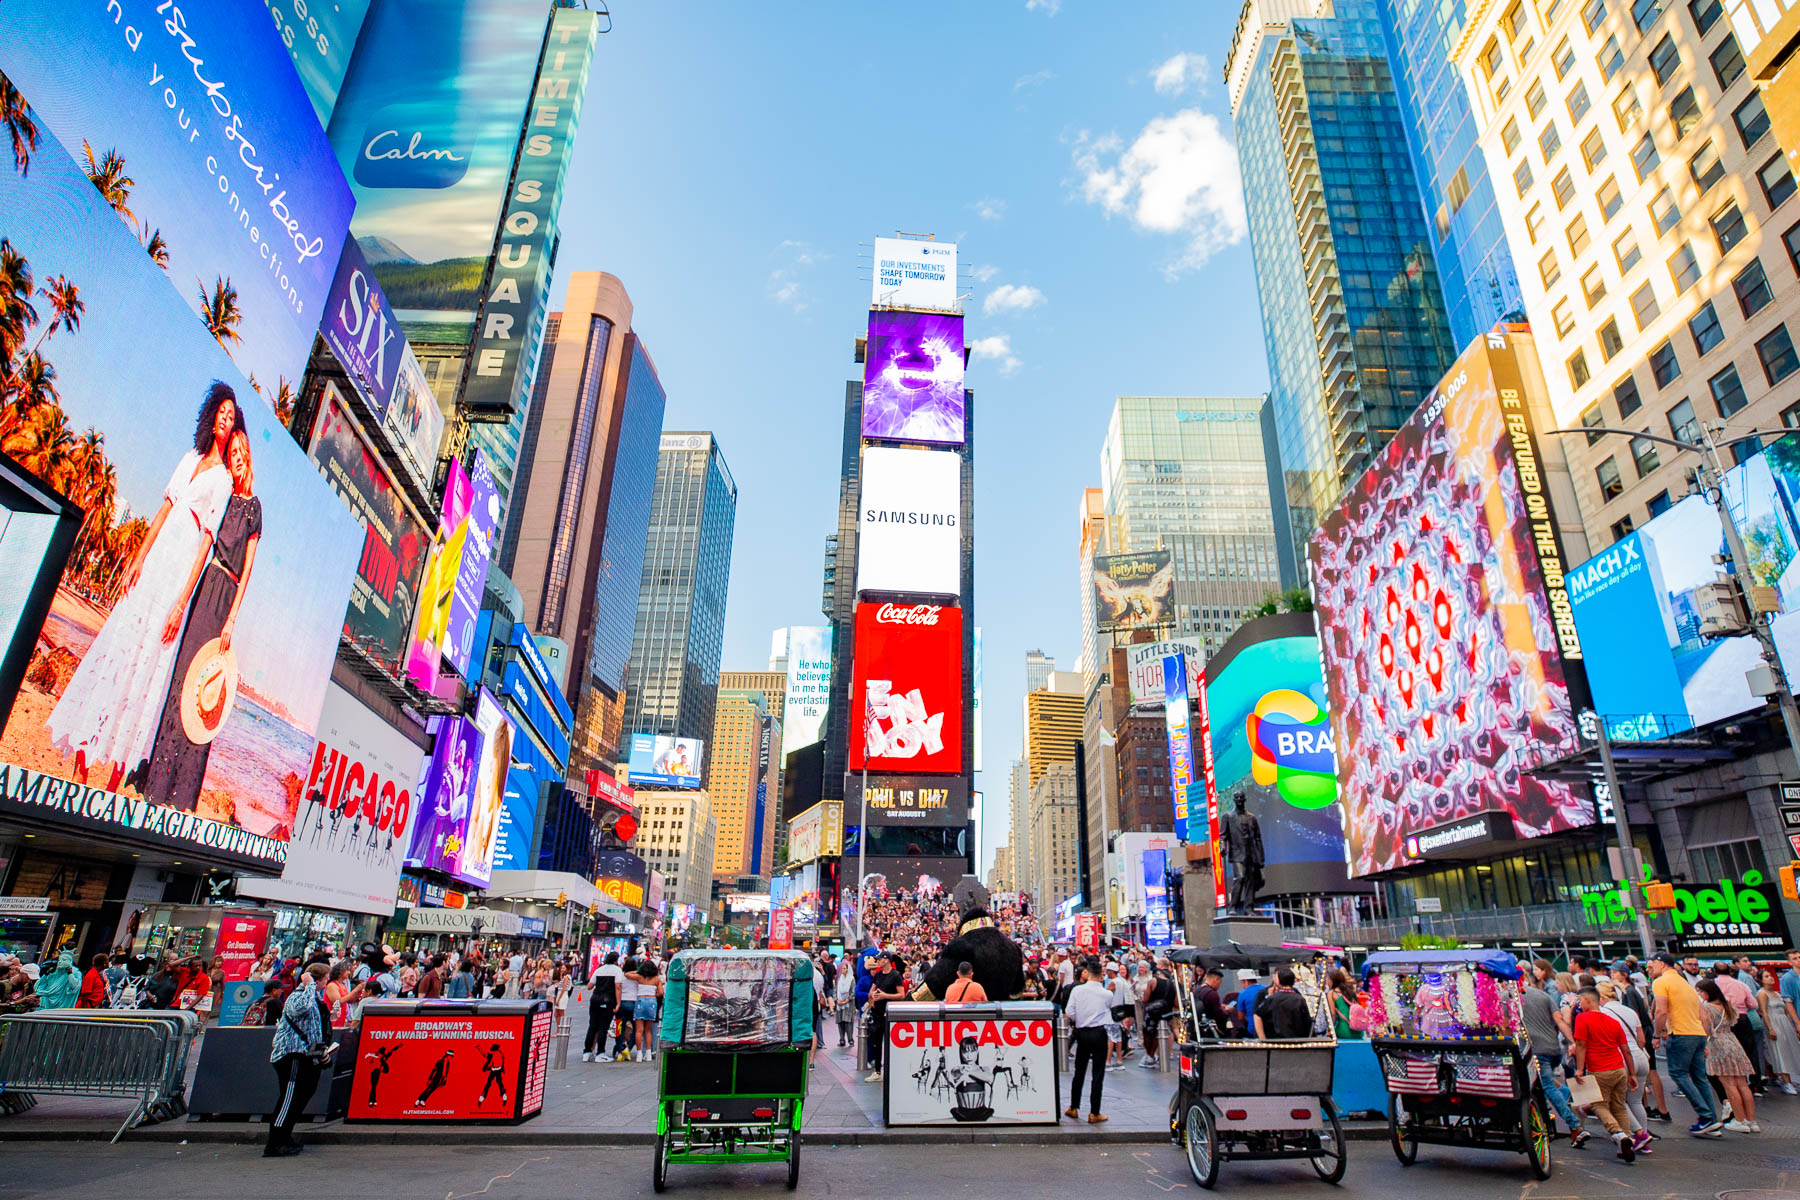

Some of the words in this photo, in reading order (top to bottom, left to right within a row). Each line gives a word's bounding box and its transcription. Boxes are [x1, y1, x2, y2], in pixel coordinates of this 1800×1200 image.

[526, 25, 578, 157] TIMES
[365, 130, 464, 161] Calm
[148, 62, 200, 142] your
[206, 155, 304, 314] connections
[477, 180, 541, 377] SQUARE
[880, 259, 896, 268] OUR
[897, 261, 945, 273] INVESTMENTS
[880, 268, 903, 278] SHAPE
[905, 270, 946, 281] TOMORROW
[880, 277, 903, 287] TODAY
[339, 270, 395, 390] SIX
[1422, 370, 1468, 428] 1930.006
[1501, 388, 1521, 408] BE
[1506, 413, 1541, 493] FEATURED
[867, 509, 956, 527] SAMSUNG
[1526, 494, 1547, 519] ON
[1532, 516, 1557, 557] THE
[1109, 562, 1132, 579] Harry
[1131, 560, 1158, 576] Potter
[1541, 558, 1565, 589] BIG
[1570, 549, 1623, 597] MACH
[1622, 538, 1640, 565] X
[1574, 595, 1586, 606] Run
[1585, 589, 1596, 599] like
[1595, 582, 1609, 594] race
[1608, 574, 1621, 585] day
[1620, 567, 1630, 579] all
[1629, 562, 1642, 574] day
[1549, 588, 1583, 661] SCREEN
[799, 659, 810, 669] He
[812, 659, 830, 670] who
[1135, 643, 1169, 665] LITTLE
[1171, 642, 1198, 658] SHOP
[792, 683, 800, 693] in
[802, 684, 816, 693] me
[818, 683, 829, 693] ha
[796, 671, 831, 681] believes
[1136, 660, 1198, 697] HORRS
[803, 706, 819, 717] life.
[305, 740, 410, 839] HICAGO
[865, 788, 896, 809] PAUL
[900, 790, 914, 806] VS
[919, 788, 949, 809] DIAZ
[0, 768, 141, 830] AMERICAN
[143, 801, 203, 843] EAGLE
[203, 822, 289, 863] OUTFITTERS
[1670, 869, 1771, 935] pelé
[409, 912, 496, 928] SWAROVKI
[775, 911, 790, 940] tkts
[1079, 914, 1095, 945] tkts
[1693, 923, 1761, 935] SOCCER
[370, 1030, 394, 1040] TONY
[395, 1030, 473, 1040] AWARD-WINNING
[474, 1030, 515, 1040] MUSICAL
[414, 1021, 473, 1031] BROADWAY'S
[890, 1020, 1053, 1049] CHICAGO
